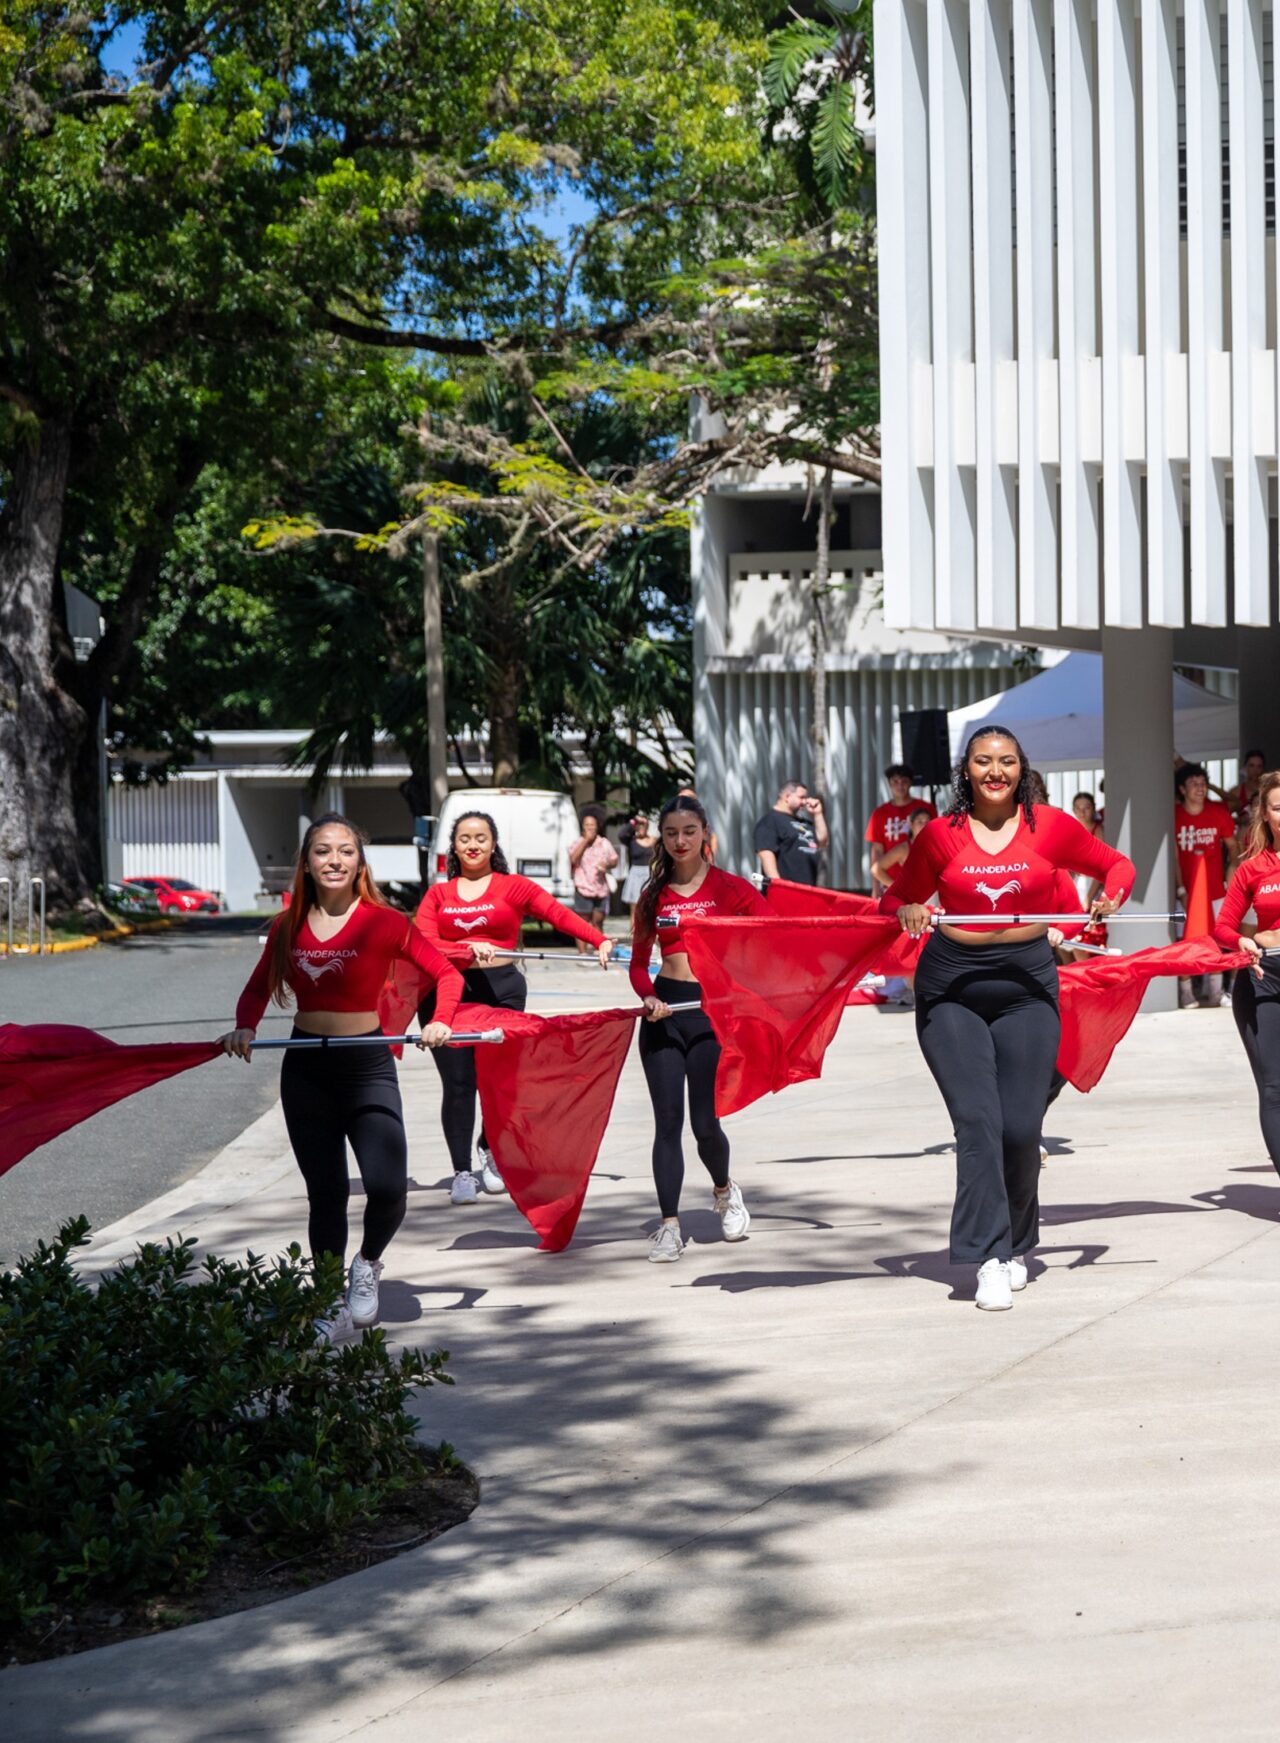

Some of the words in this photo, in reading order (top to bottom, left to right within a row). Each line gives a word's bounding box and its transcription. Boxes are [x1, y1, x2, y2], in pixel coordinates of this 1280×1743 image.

[961, 862, 1030, 874] ABANDERADA
[442, 903, 495, 914] ABANDERADA
[661, 900, 717, 912] ABANDERADA
